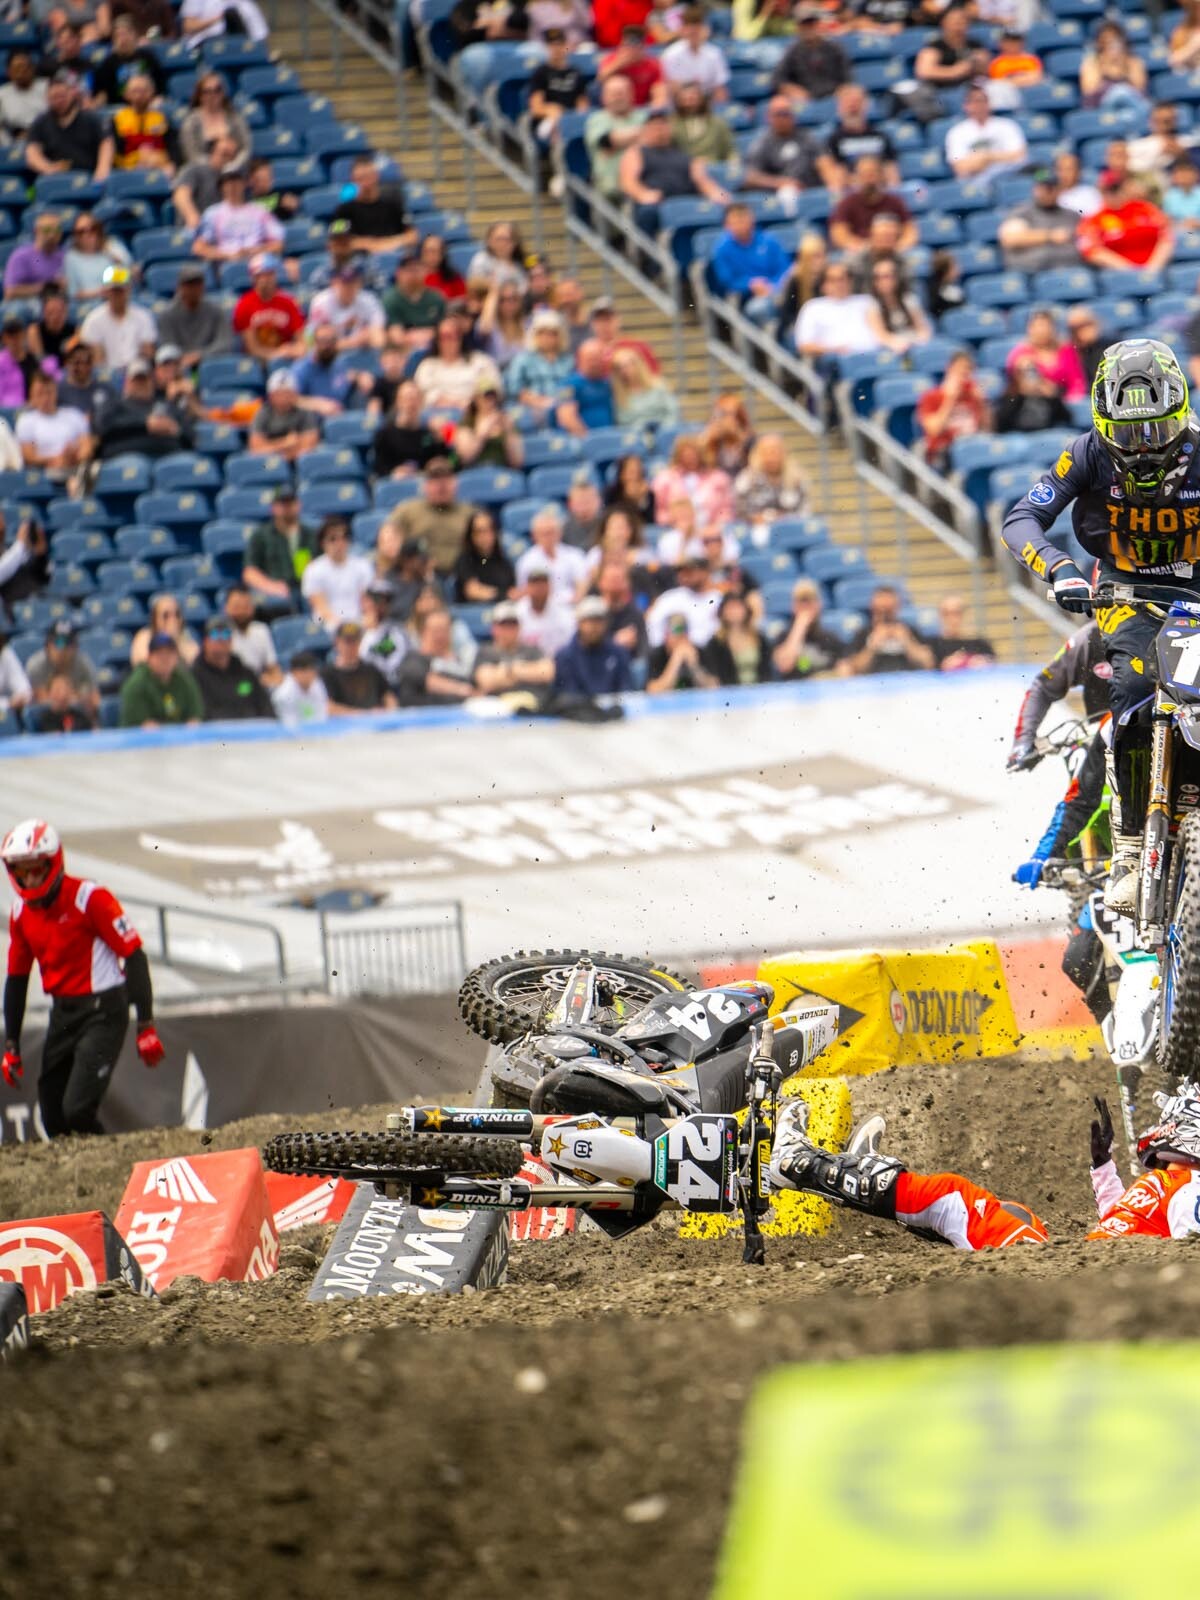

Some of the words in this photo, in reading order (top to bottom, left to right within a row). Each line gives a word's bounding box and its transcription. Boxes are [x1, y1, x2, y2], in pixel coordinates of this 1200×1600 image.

[1106, 503, 1200, 533] THOR
[666, 991, 743, 1042] 24
[799, 1008, 829, 1021] DUNLOP
[906, 989, 983, 1035] DUNLOP
[452, 1113, 526, 1125] DUNLOP
[667, 1121, 722, 1207] 24
[450, 1192, 525, 1207] DUNLOP
